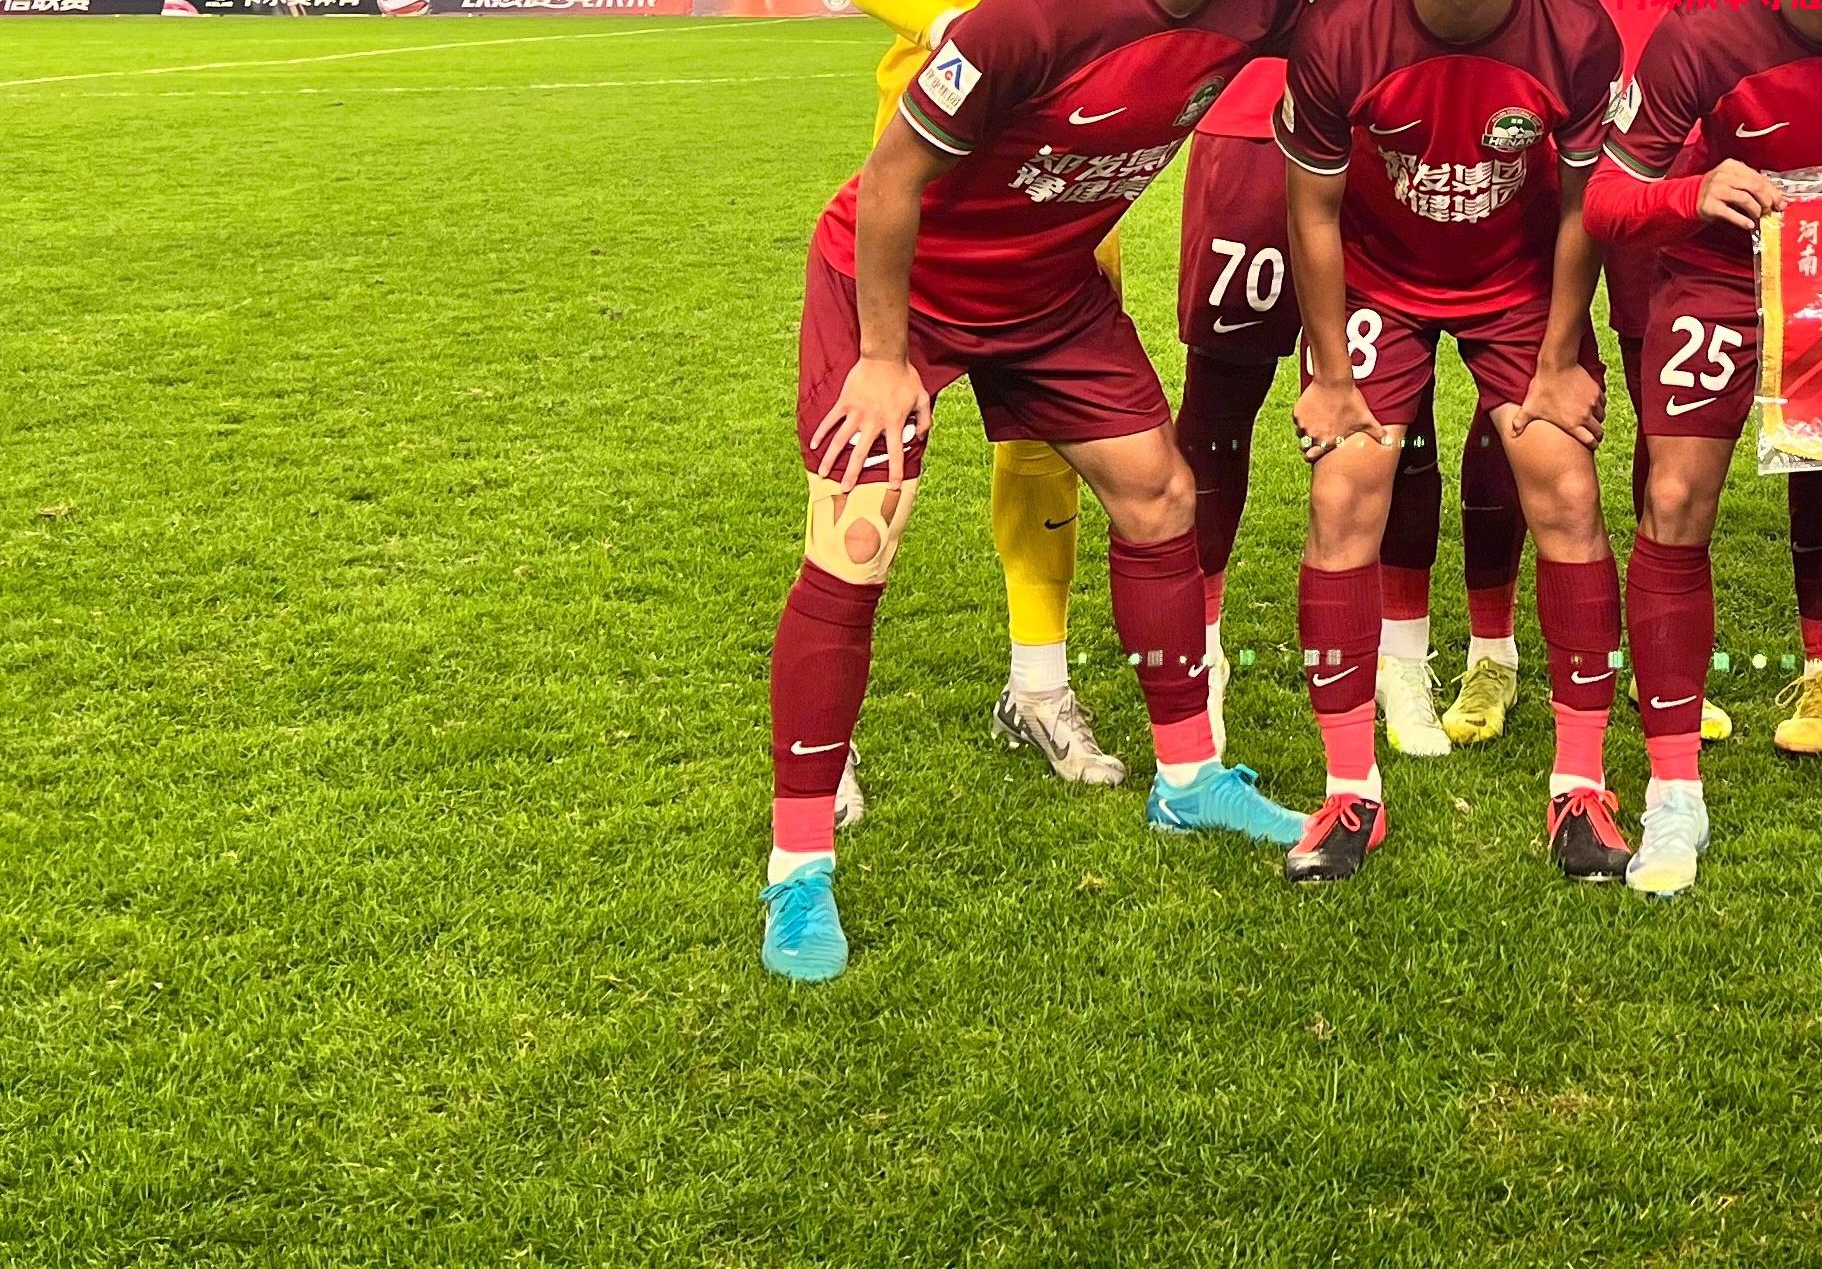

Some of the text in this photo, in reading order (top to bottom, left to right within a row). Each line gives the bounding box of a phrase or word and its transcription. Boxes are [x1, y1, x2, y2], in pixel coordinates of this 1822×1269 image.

[1489, 135, 1536, 147] HENAN
[1209, 238, 1284, 312] 70
[1797, 220, 1818, 276] 河南
[1306, 309, 1383, 380] 8
[1660, 315, 1743, 391] 25
